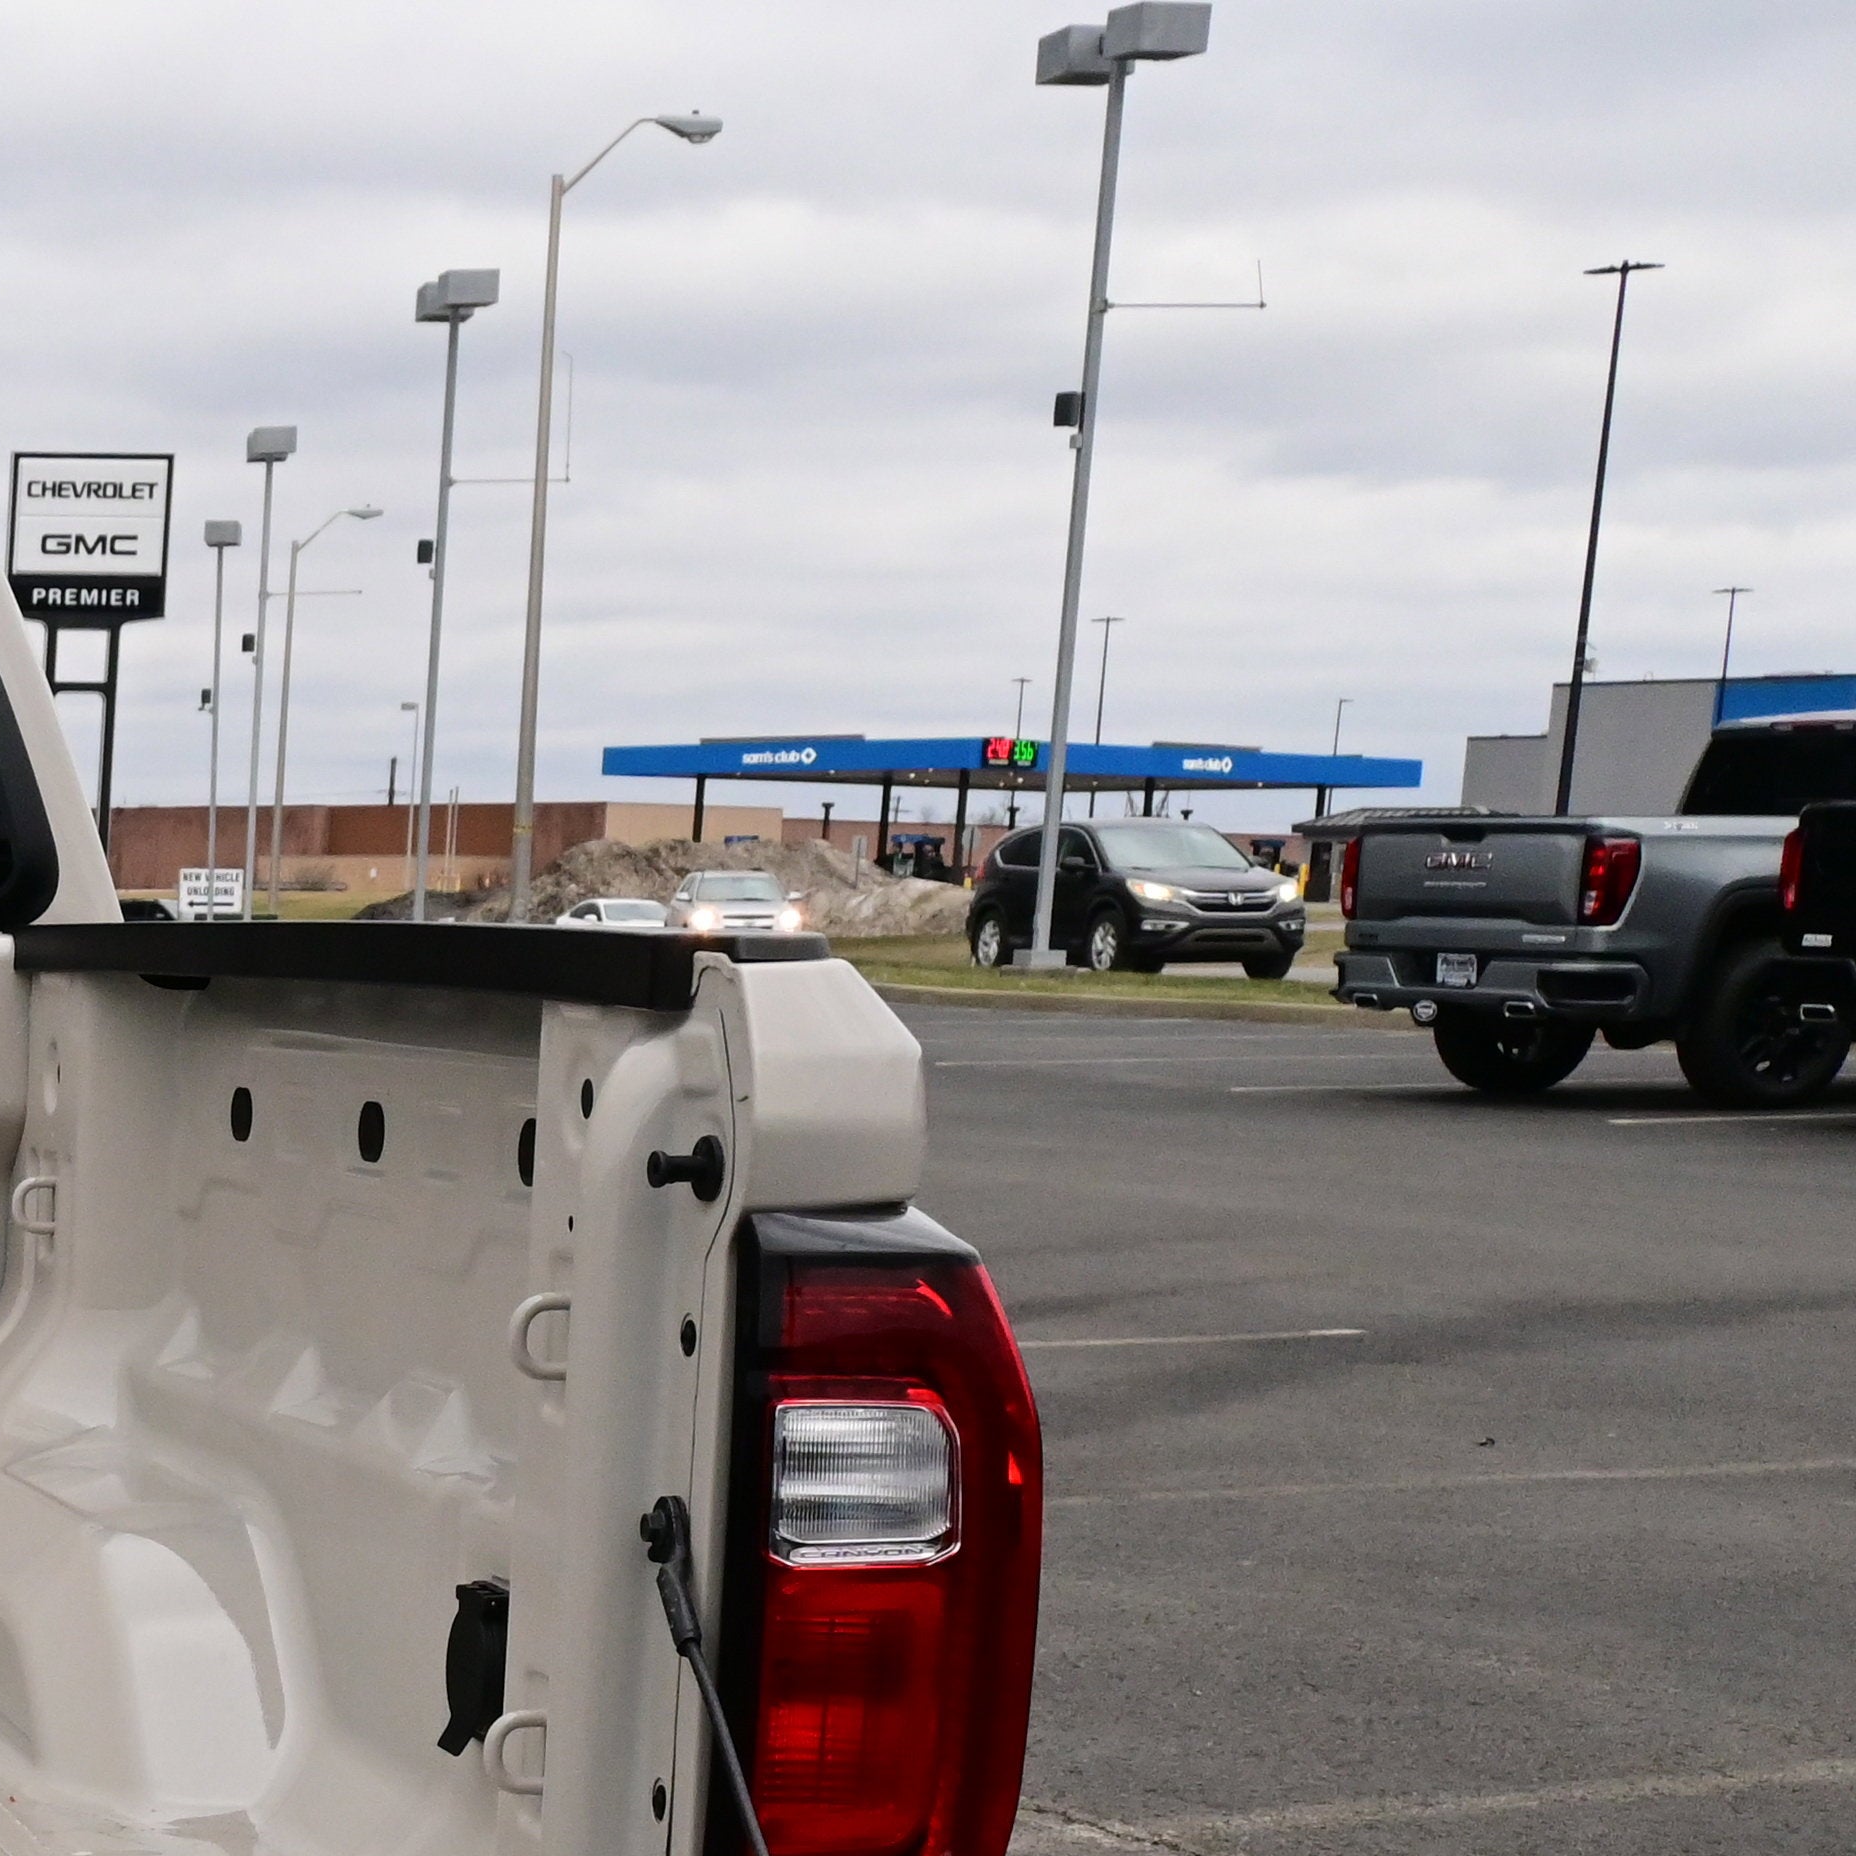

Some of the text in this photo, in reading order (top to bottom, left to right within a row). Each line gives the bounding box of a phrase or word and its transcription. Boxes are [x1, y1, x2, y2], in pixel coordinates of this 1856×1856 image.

[26, 480, 158, 500] CHEVROLET
[40, 533, 139, 556] GMC
[31, 587, 140, 607] PREMIER
[183, 873, 240, 882] NEW VHICLE
[187, 886, 235, 896] UNLODING
